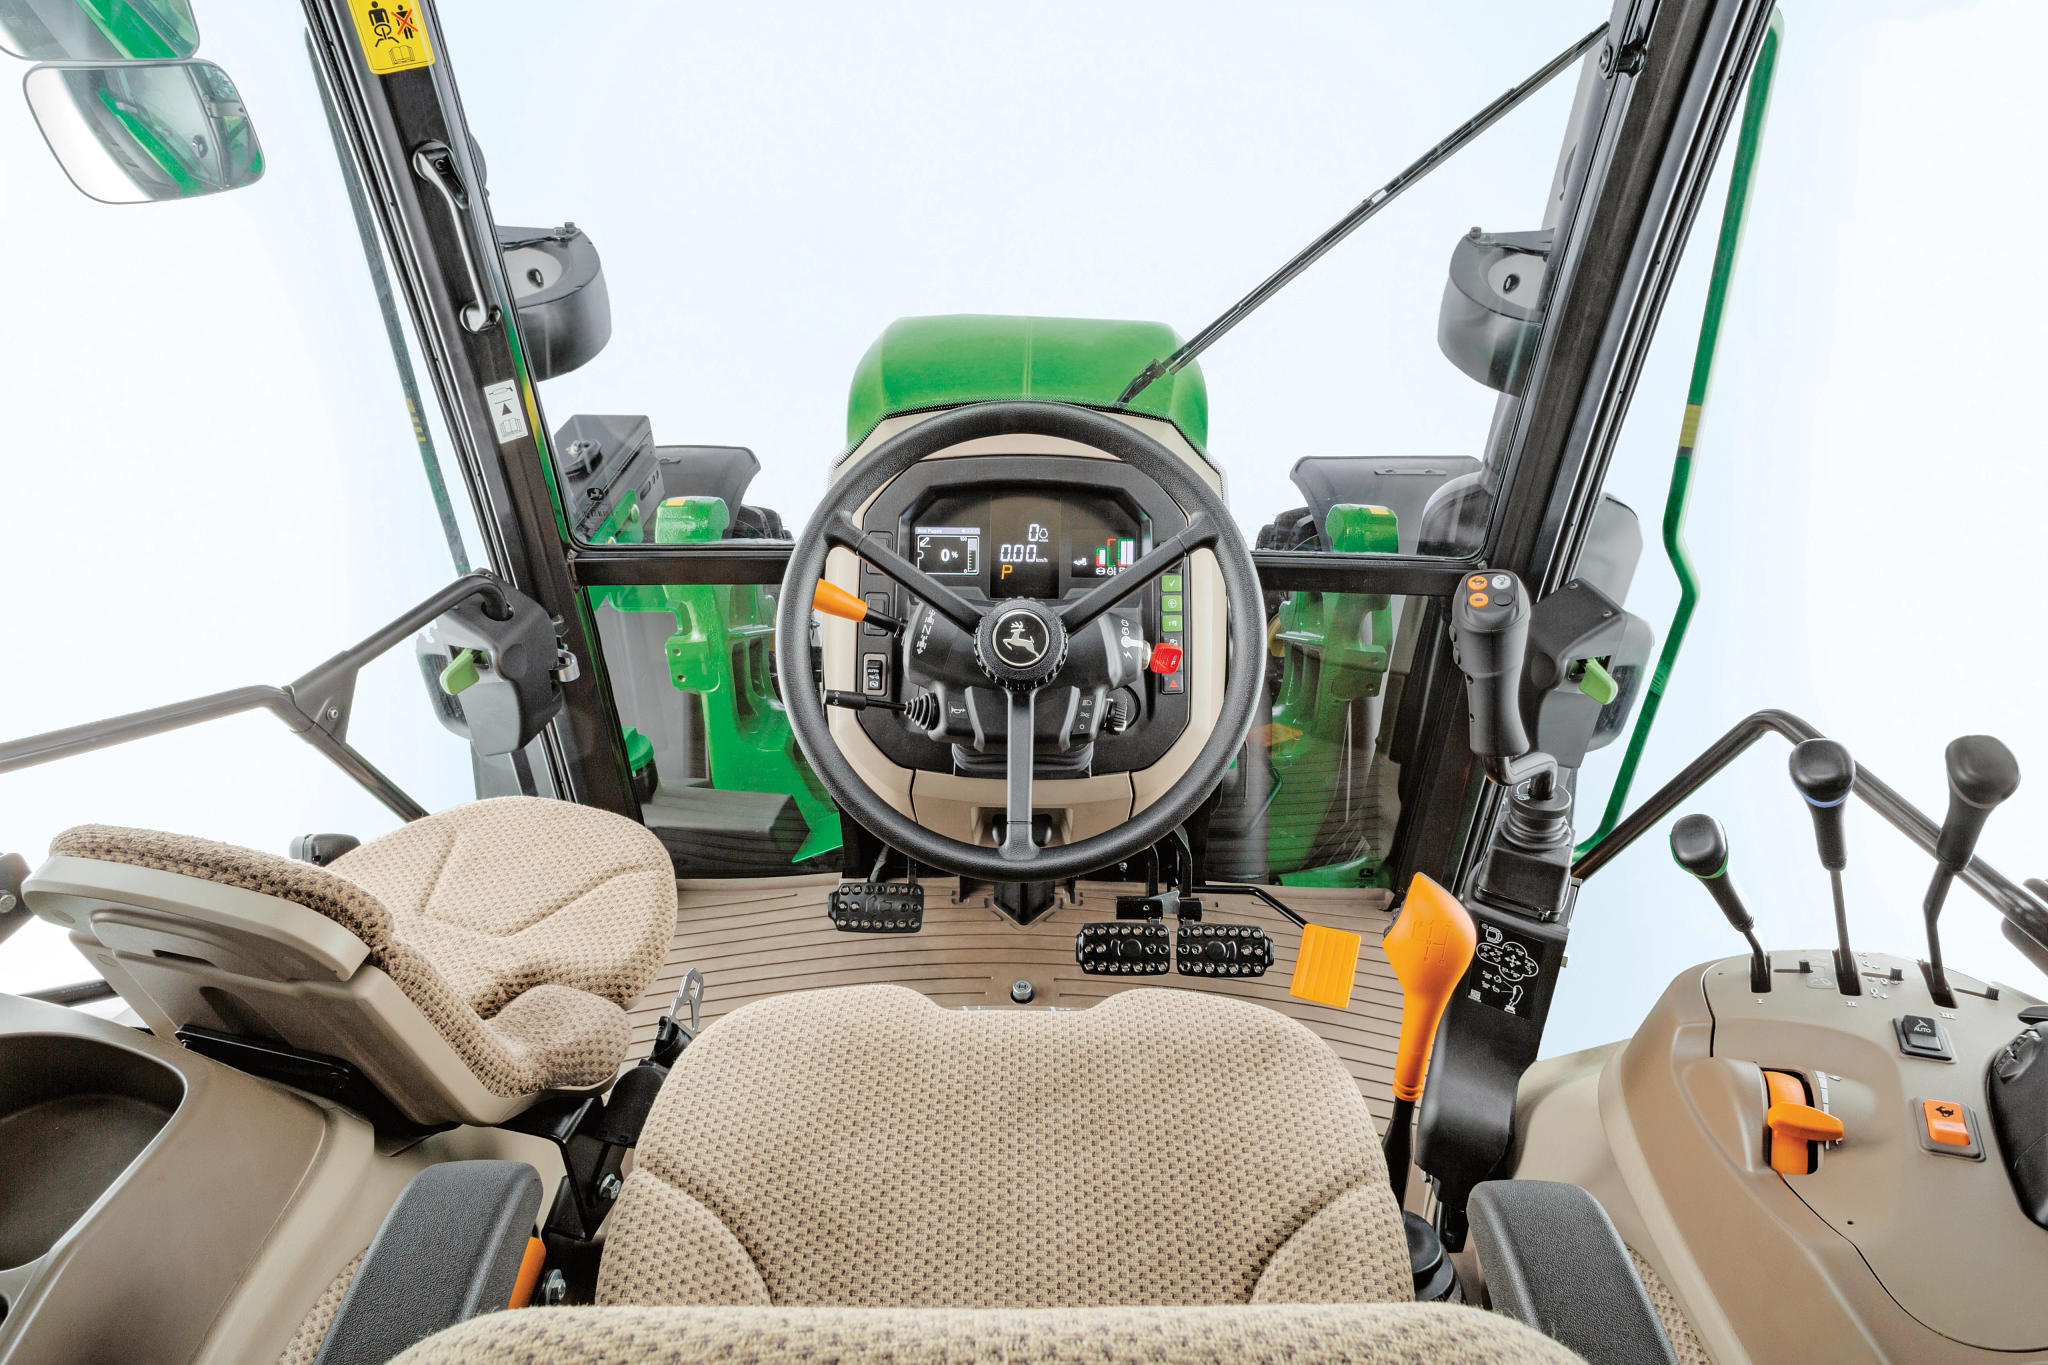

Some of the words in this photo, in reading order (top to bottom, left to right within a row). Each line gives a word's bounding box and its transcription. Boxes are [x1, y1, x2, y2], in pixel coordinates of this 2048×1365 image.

[1028, 523, 1040, 542] 0
[940, 548, 950, 562] 0
[1000, 543, 1037, 562] 0.00
[1001, 564, 1013, 580] P
[921, 623, 932, 635] N
